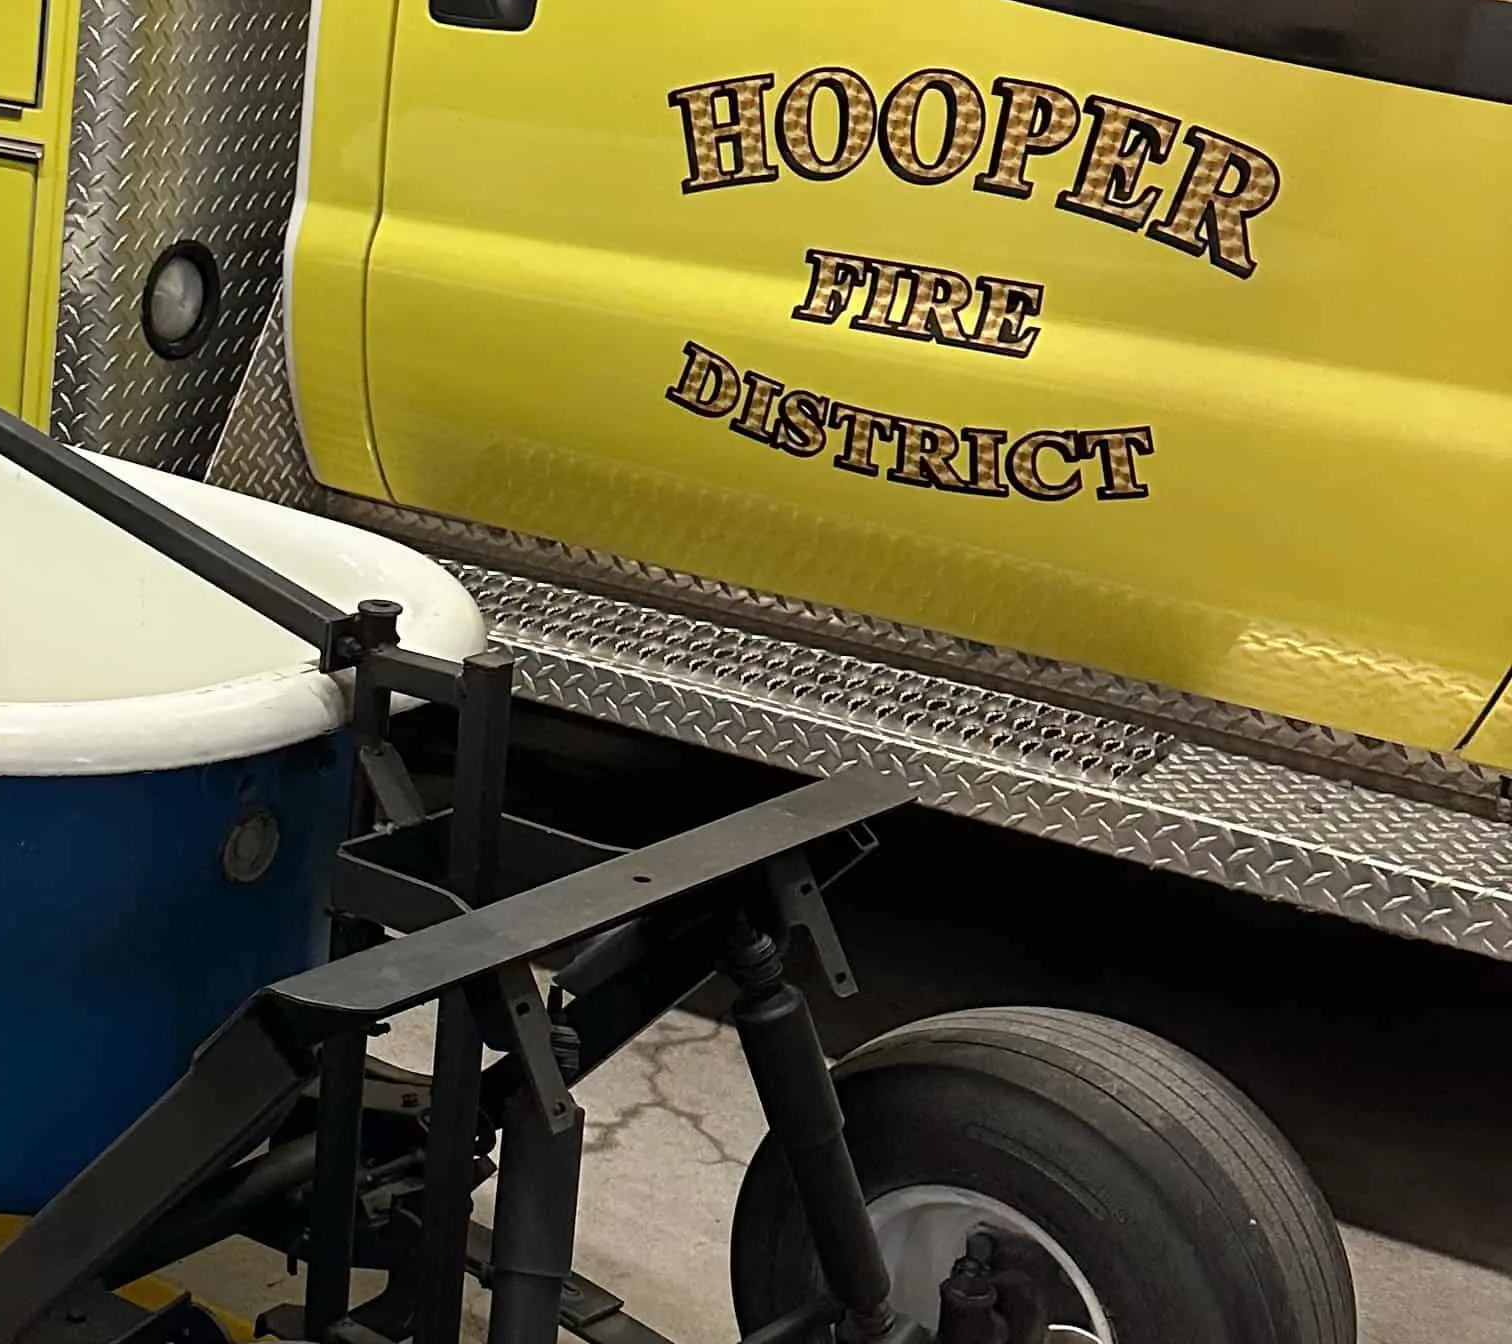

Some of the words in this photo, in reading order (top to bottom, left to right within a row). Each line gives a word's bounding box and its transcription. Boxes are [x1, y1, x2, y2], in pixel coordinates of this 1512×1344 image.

[669, 67, 1281, 279] HOOPER
[791, 248, 1044, 359] FIRE
[665, 340, 1154, 501] DISTRICT
